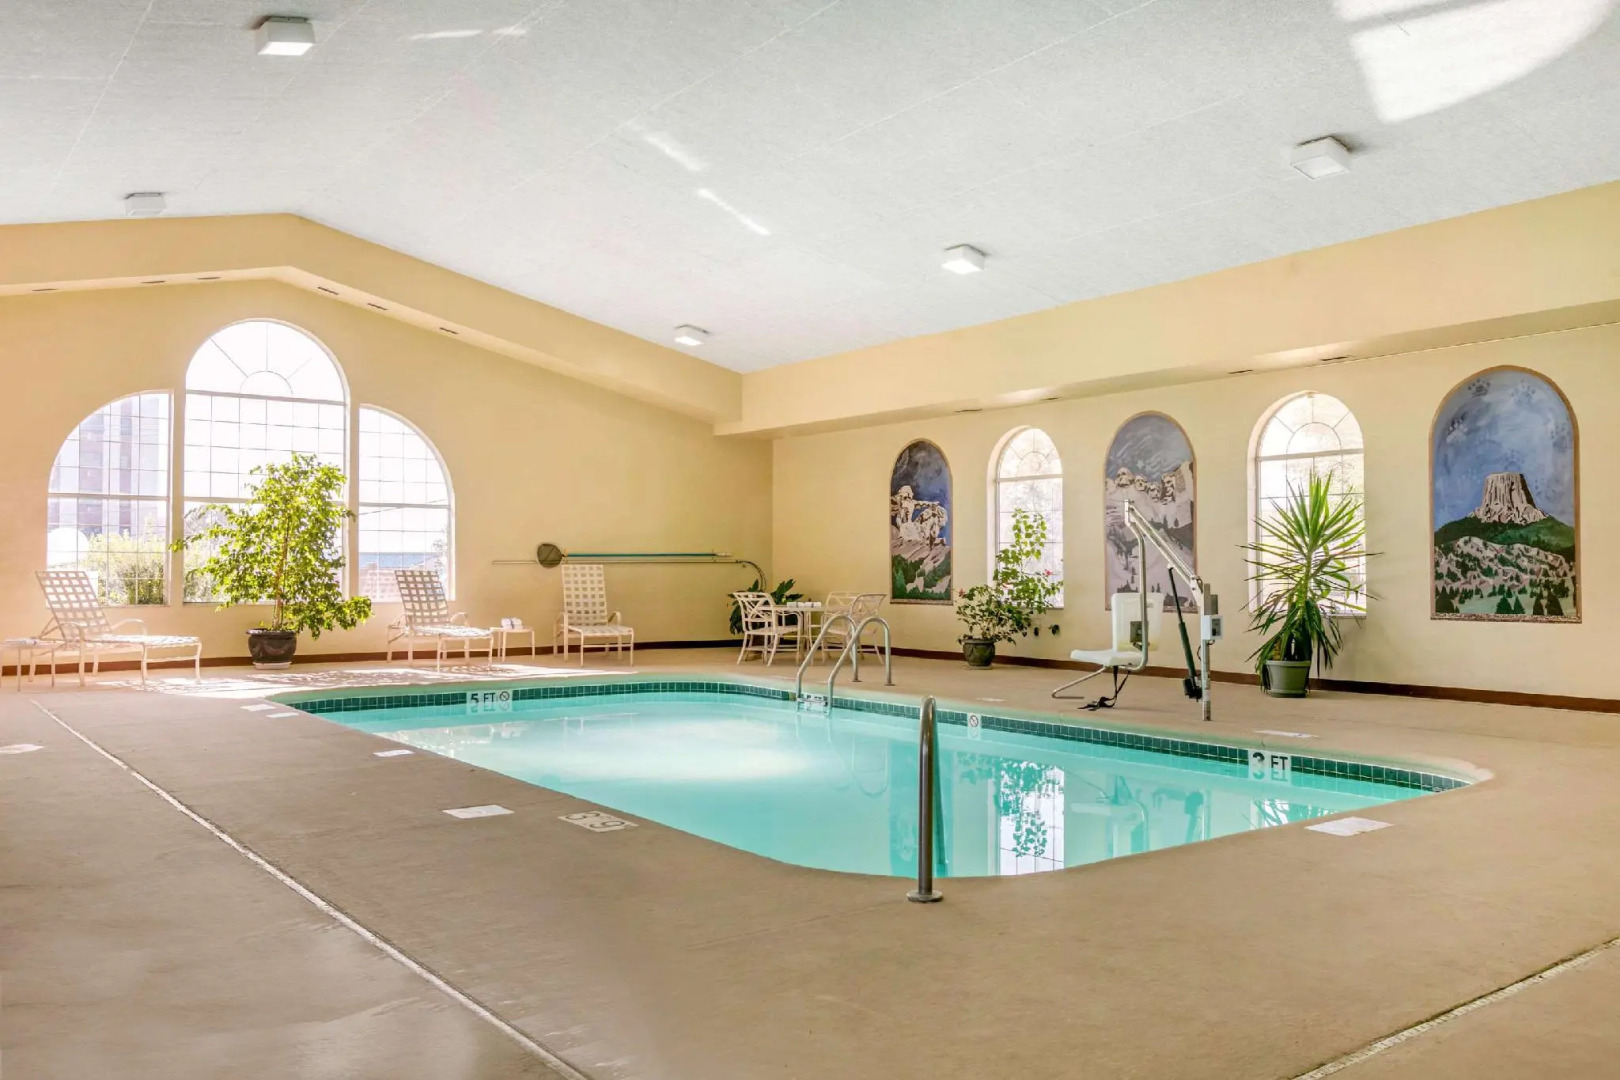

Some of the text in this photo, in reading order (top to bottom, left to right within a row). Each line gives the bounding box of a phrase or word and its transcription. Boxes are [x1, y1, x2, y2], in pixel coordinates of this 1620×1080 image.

[470, 692, 496, 704] 5 FT
[1270, 754, 1289, 771] FT
